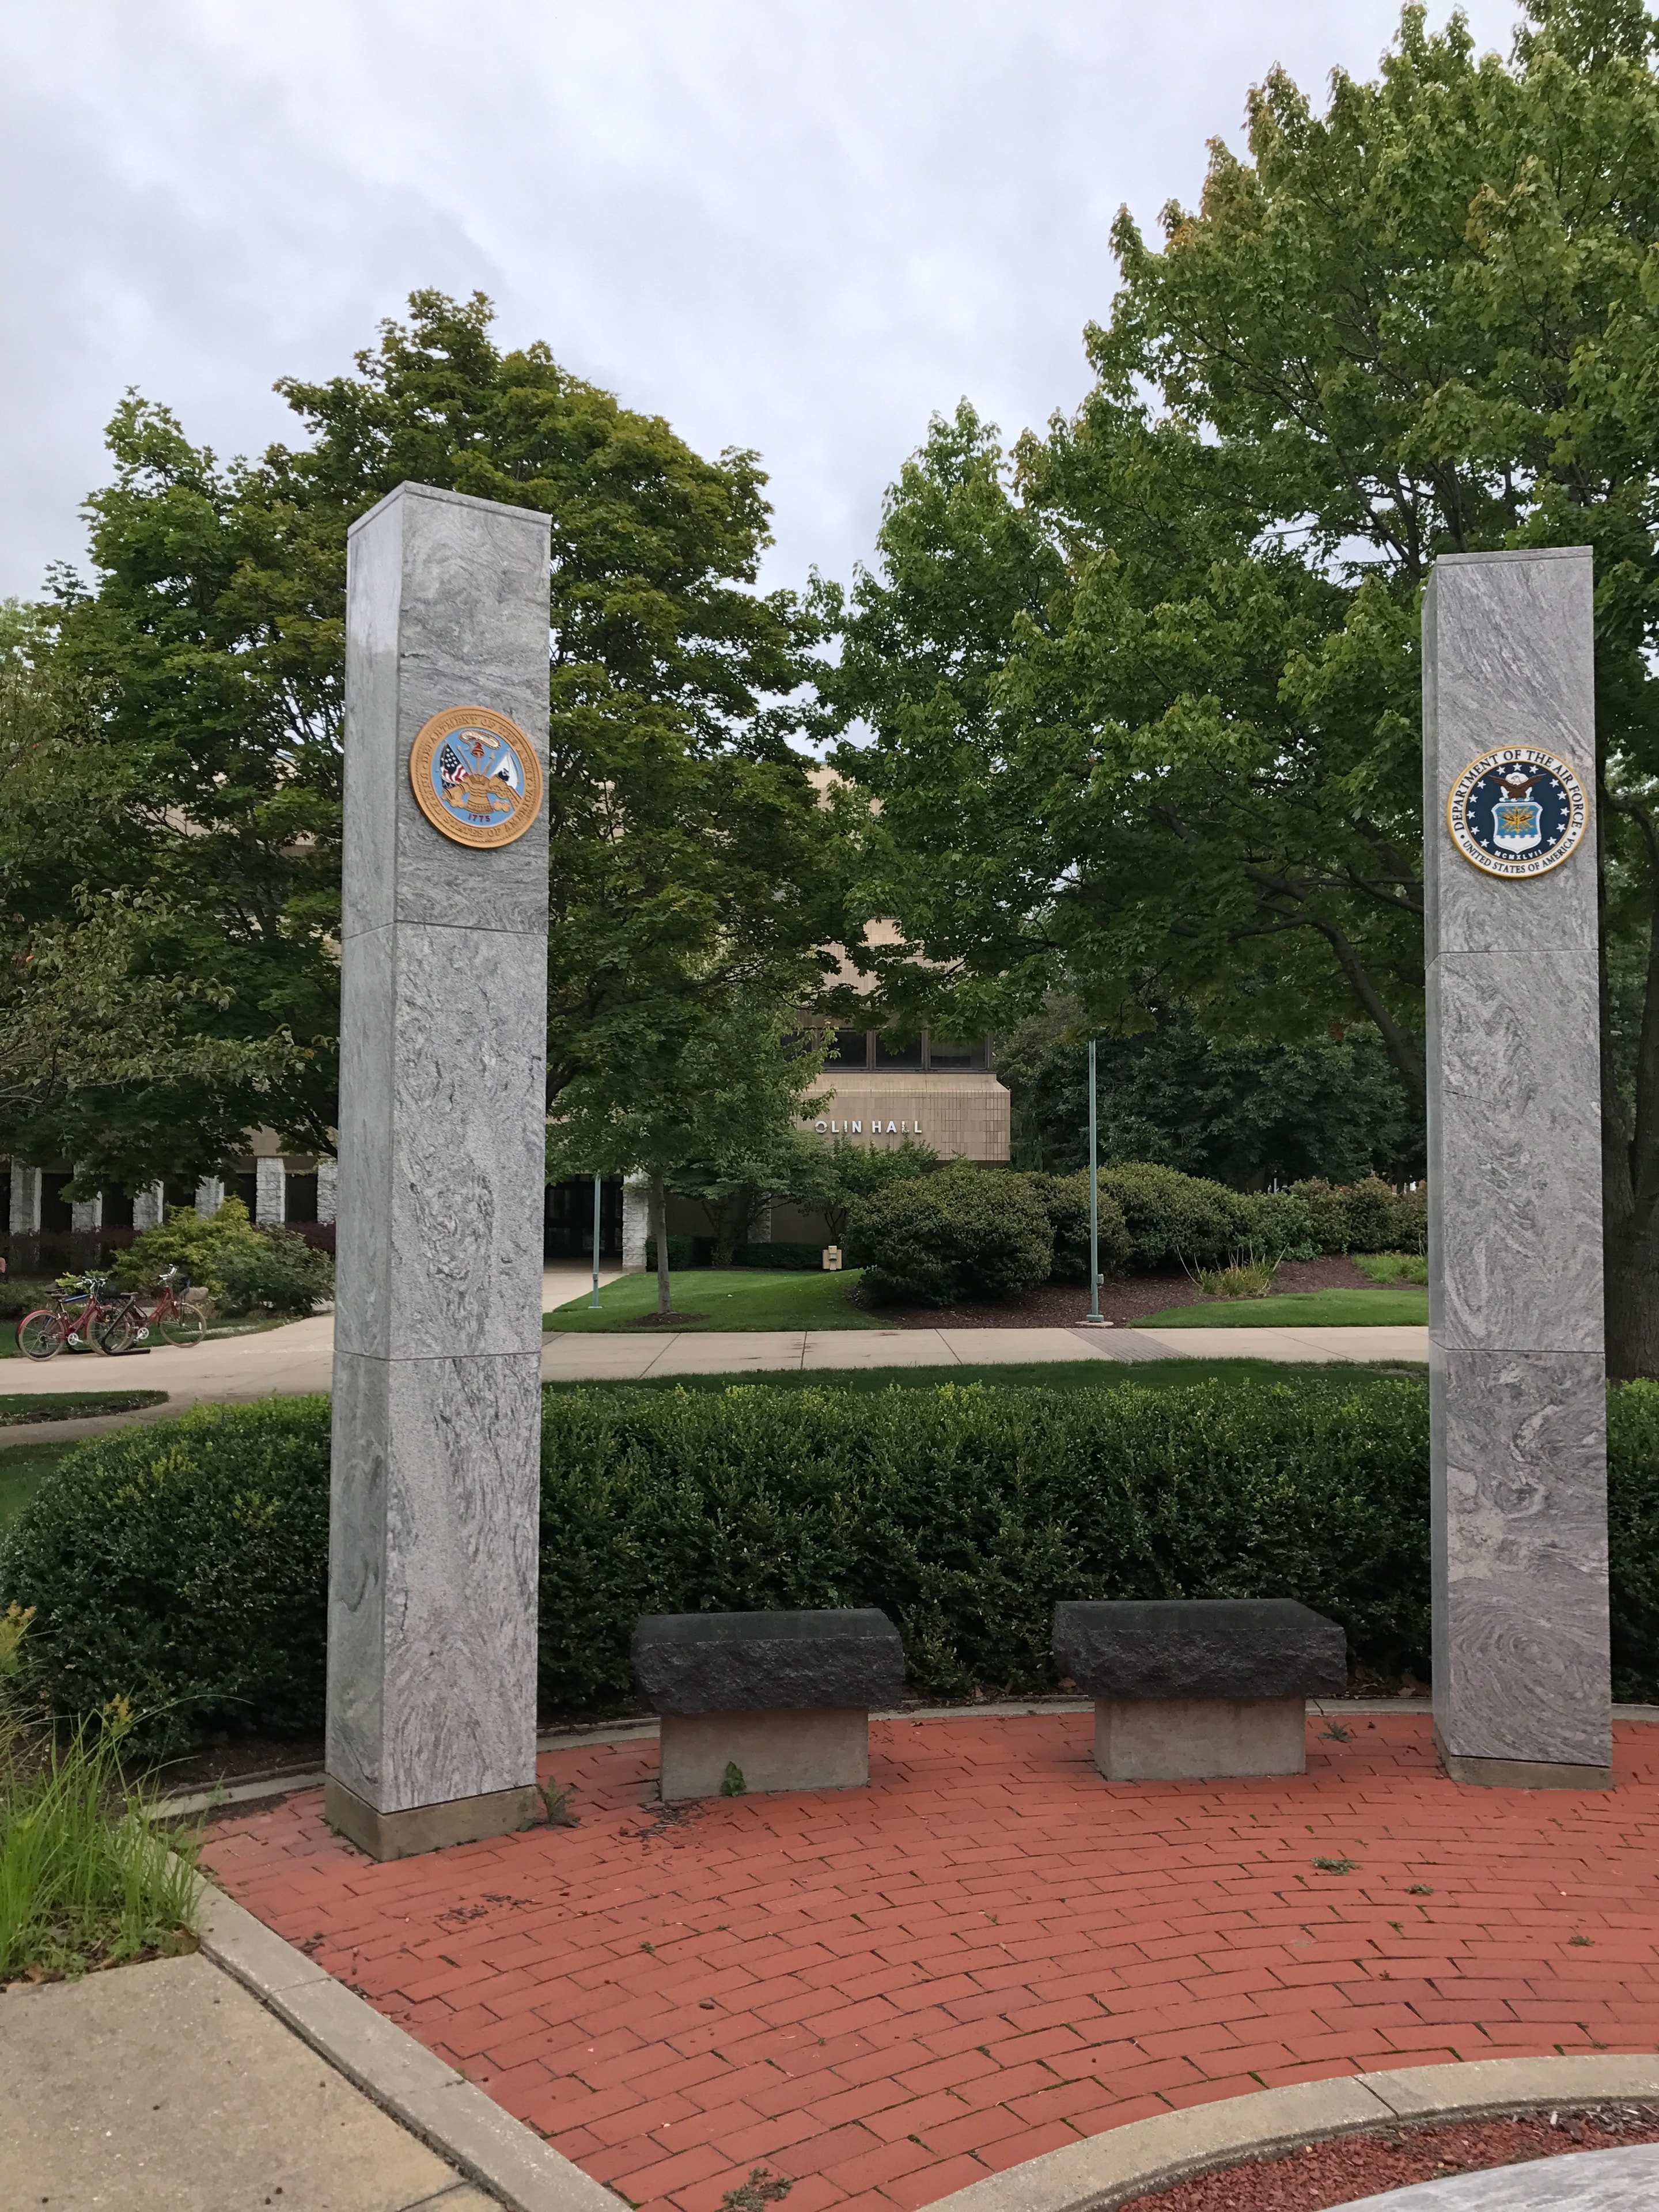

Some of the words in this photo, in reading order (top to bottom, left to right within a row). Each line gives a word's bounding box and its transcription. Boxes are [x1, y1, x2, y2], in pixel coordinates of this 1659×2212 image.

[481, 718, 495, 729] OF
[1452, 755, 1498, 831] DEPARTMENT
[1503, 749, 1521, 761] OF
[1527, 750, 1555, 767] THE
[1552, 765, 1573, 785] AIR
[1569, 785, 1584, 828] FORCE
[468, 813, 490, 823] 1775
[487, 828, 501, 837] OF
[1462, 840, 1491, 866] UNITED
[1492, 862, 1525, 873] STATES
[1528, 862, 1540, 872] OF
[1542, 838, 1575, 868] AMERICA
[1494, 849, 1543, 860] MCMXLVII
[815, 1120, 862, 1133] OLIN
[872, 1120, 922, 1133] HALL
